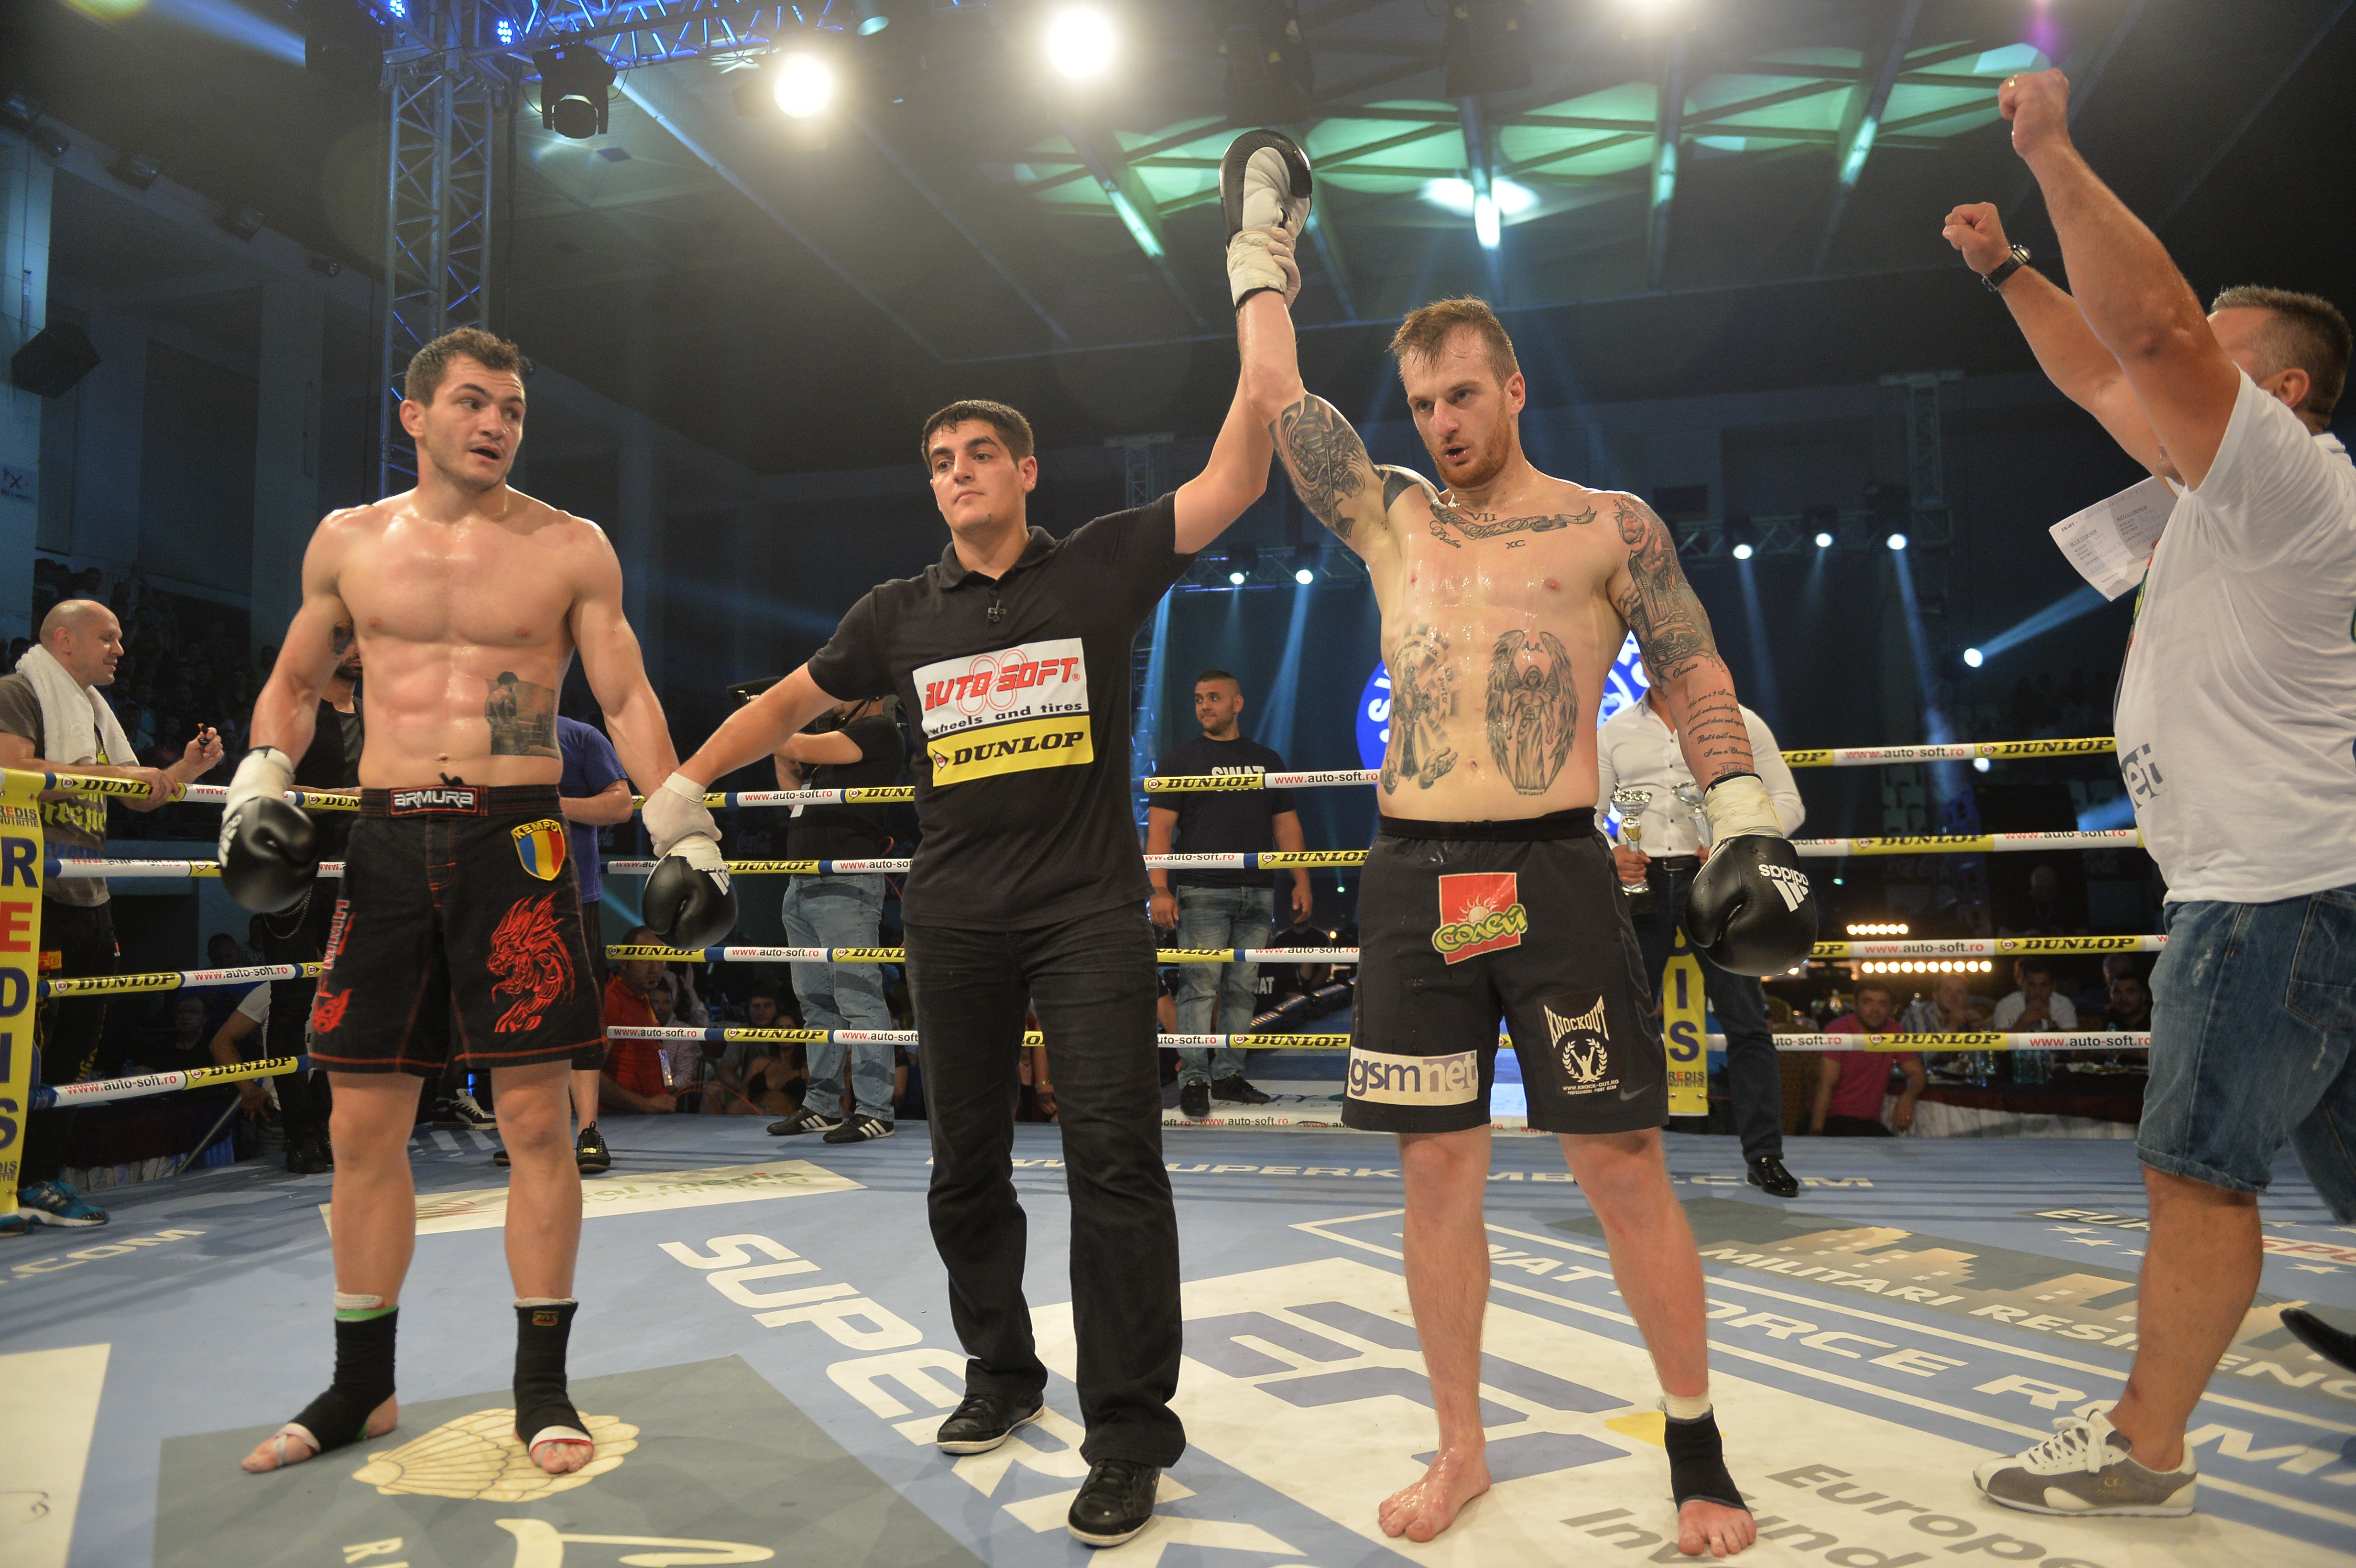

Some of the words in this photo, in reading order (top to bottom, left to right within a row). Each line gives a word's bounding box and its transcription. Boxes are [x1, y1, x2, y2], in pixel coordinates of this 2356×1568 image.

[1471, 513, 1497, 523] VII
[1505, 540, 1525, 549] XC
[925, 671, 993, 711] AUTO
[996, 657, 1079, 692] SOFT
[929, 716, 983, 735] wheels
[995, 706, 1031, 720] and
[1040, 702, 1082, 714] tires
[953, 731, 1084, 765] DUNLOP
[1845, 746, 1965, 759] www.auto-soft.ro
[2002, 739, 2115, 754] DUNLOP
[80, 778, 150, 795] DUNL
[1165, 776, 1258, 788] DUNLOP
[1275, 772, 1378, 784] www.auto-soft.ro
[323, 796, 361, 807] DUN
[745, 789, 833, 802] www.auto-soft.ro
[513, 821, 558, 840] KEMPO
[733, 860, 815, 871] DUNLOP
[1759, 863, 1809, 886] adidas
[731, 947, 819, 957] www.auto-soft.ro
[1865, 943, 1984, 954] www.auto-soft.ro
[2022, 938, 2135, 949] DUNLOP
[76, 973, 176, 990] DUNLOP
[194, 965, 288, 981] www.auto-soft.ro
[1544, 995, 1610, 1048] KNOCKOUT
[614, 1028, 697, 1038] www.auto-soft.ro
[742, 1029, 824, 1040] DUNLOP
[1251, 1035, 1348, 1047] DUNLOP
[1890, 1034, 2001, 1045] DUNLOP
[65, 1074, 177, 1095] www.auto-soft.ro
[208, 1056, 293, 1078] DUNLOP
[1562, 1079, 1619, 1091] WWW.KNOCK-OUT.RO
[1199, 1116, 1289, 1126] www.auto-soft.ro
[1701, 1247, 1966, 1307] MILITARI
